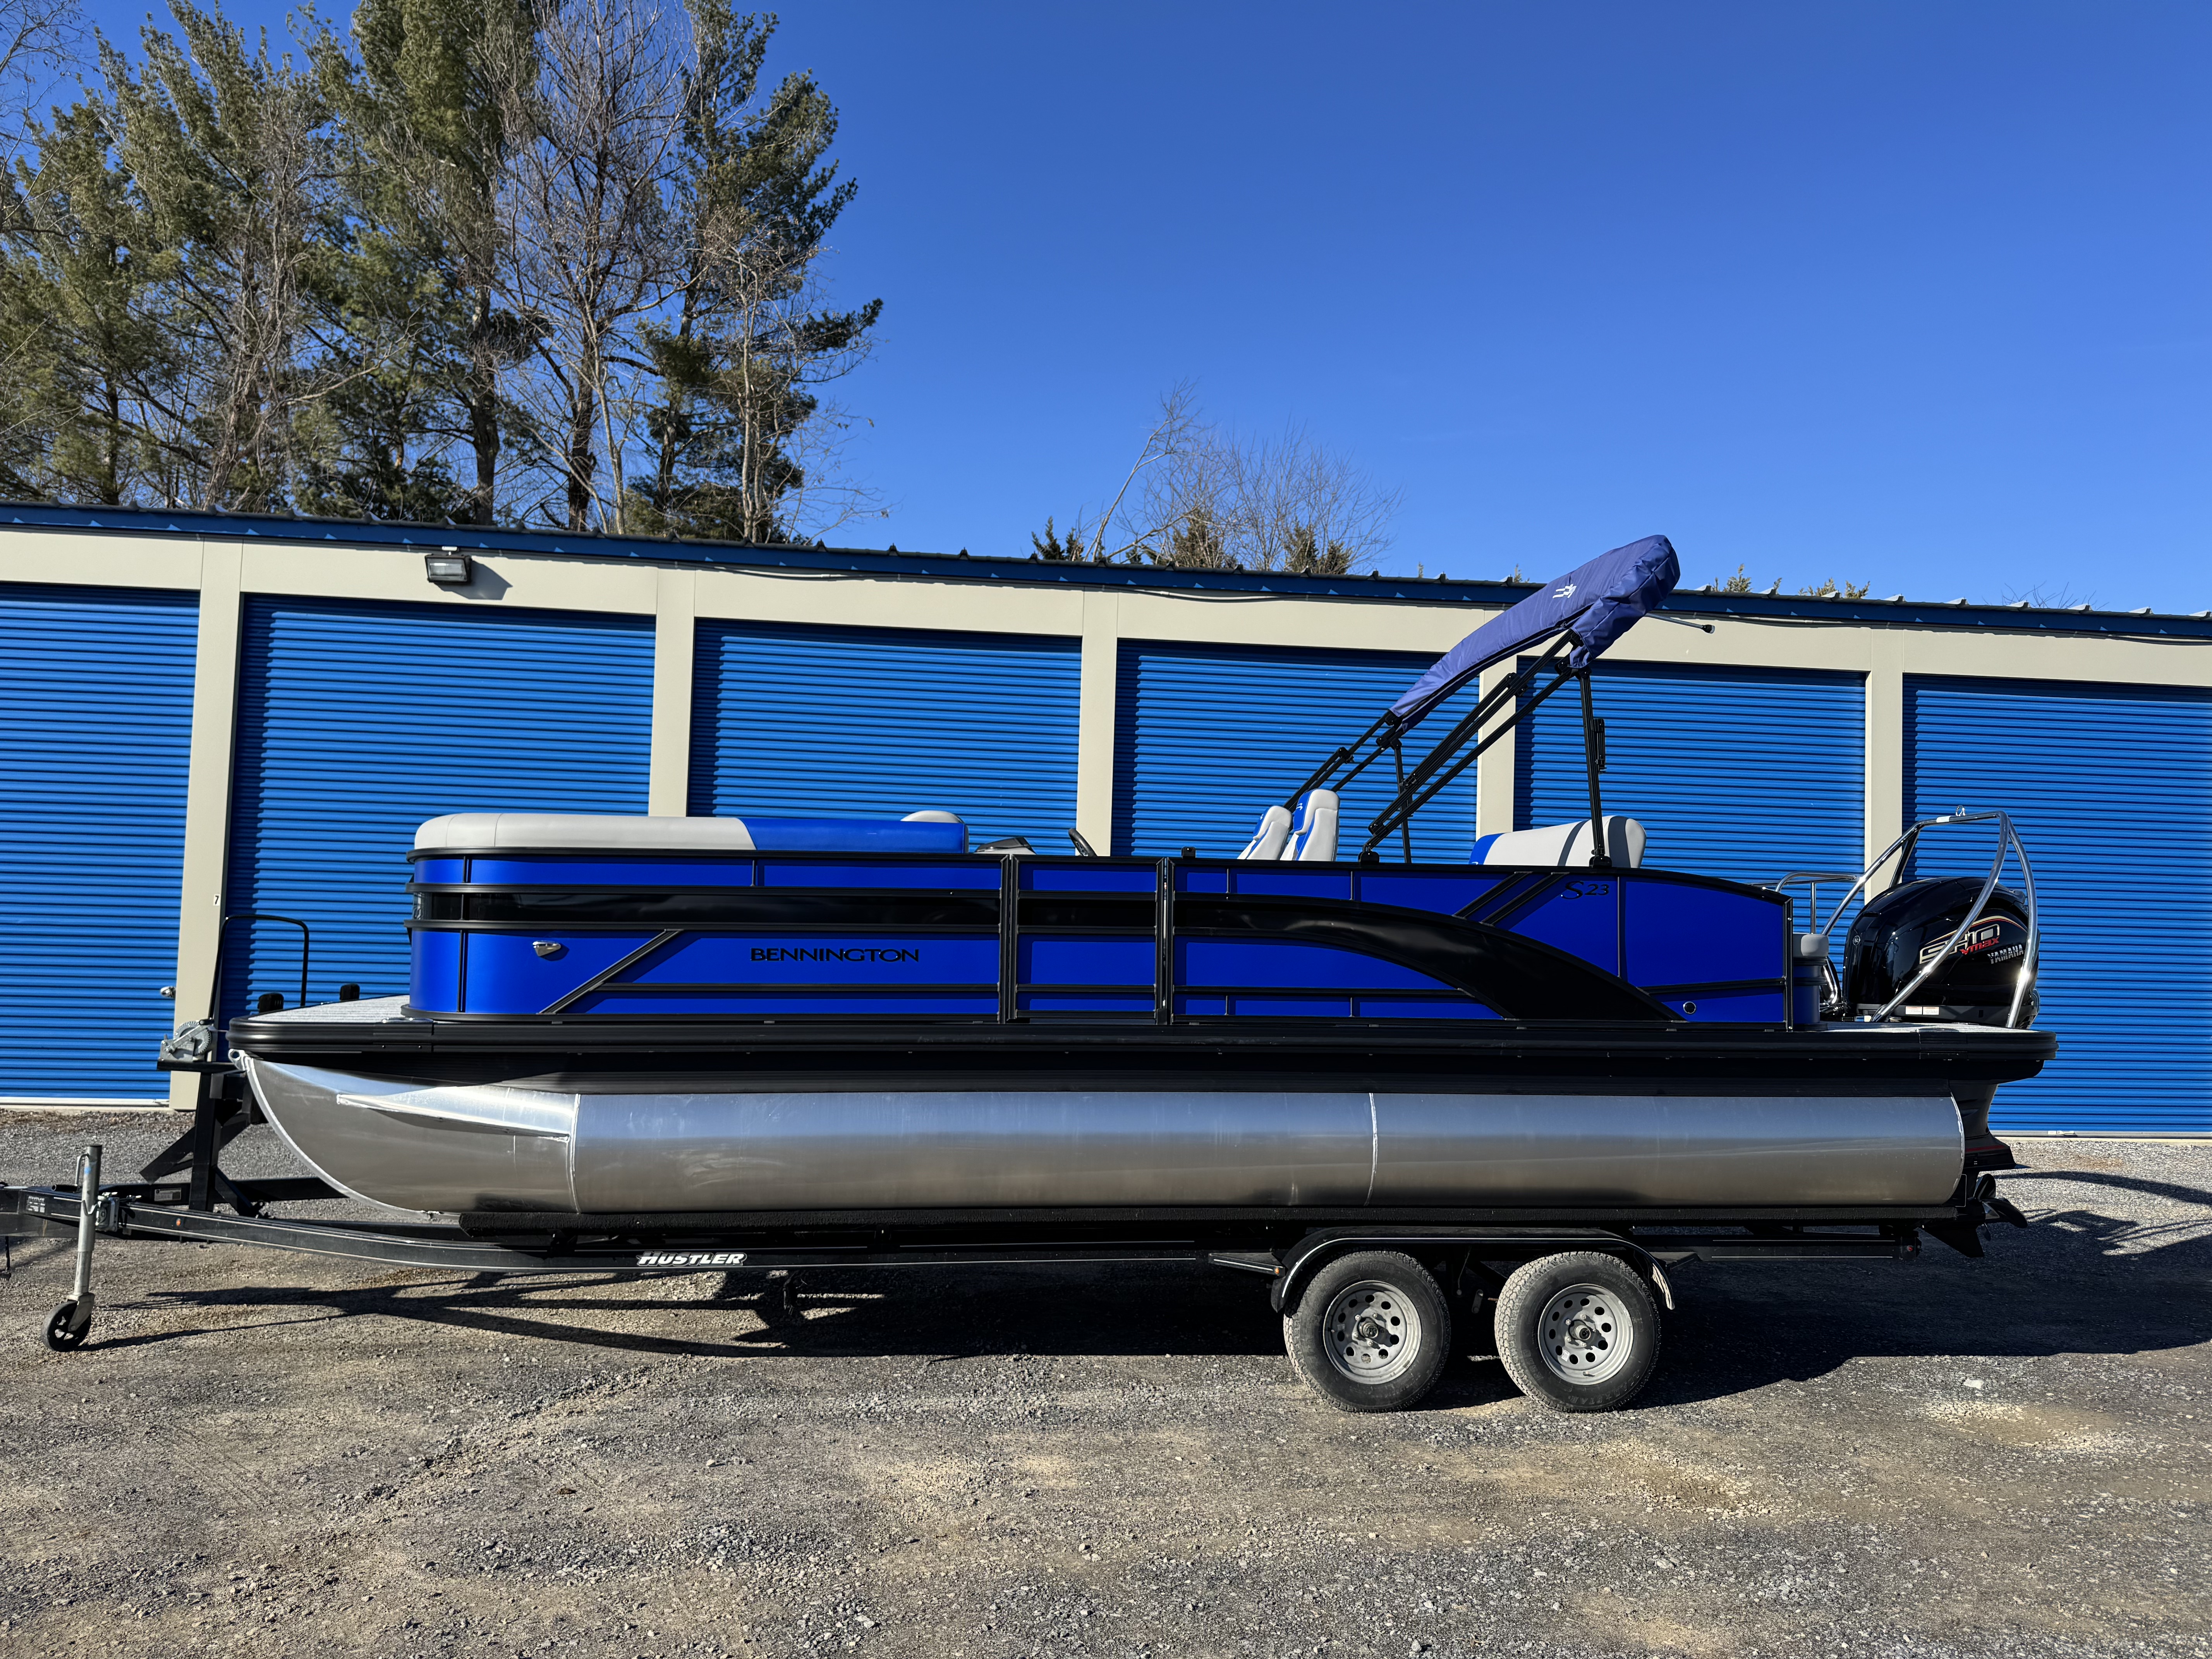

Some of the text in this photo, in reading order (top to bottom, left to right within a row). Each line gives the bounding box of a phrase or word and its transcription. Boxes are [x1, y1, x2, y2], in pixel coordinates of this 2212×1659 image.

[750, 947, 919, 962] BENNINGTON
[1987, 944, 2024, 964] YAMAHA
[636, 1250, 747, 1266] HUSTLER
